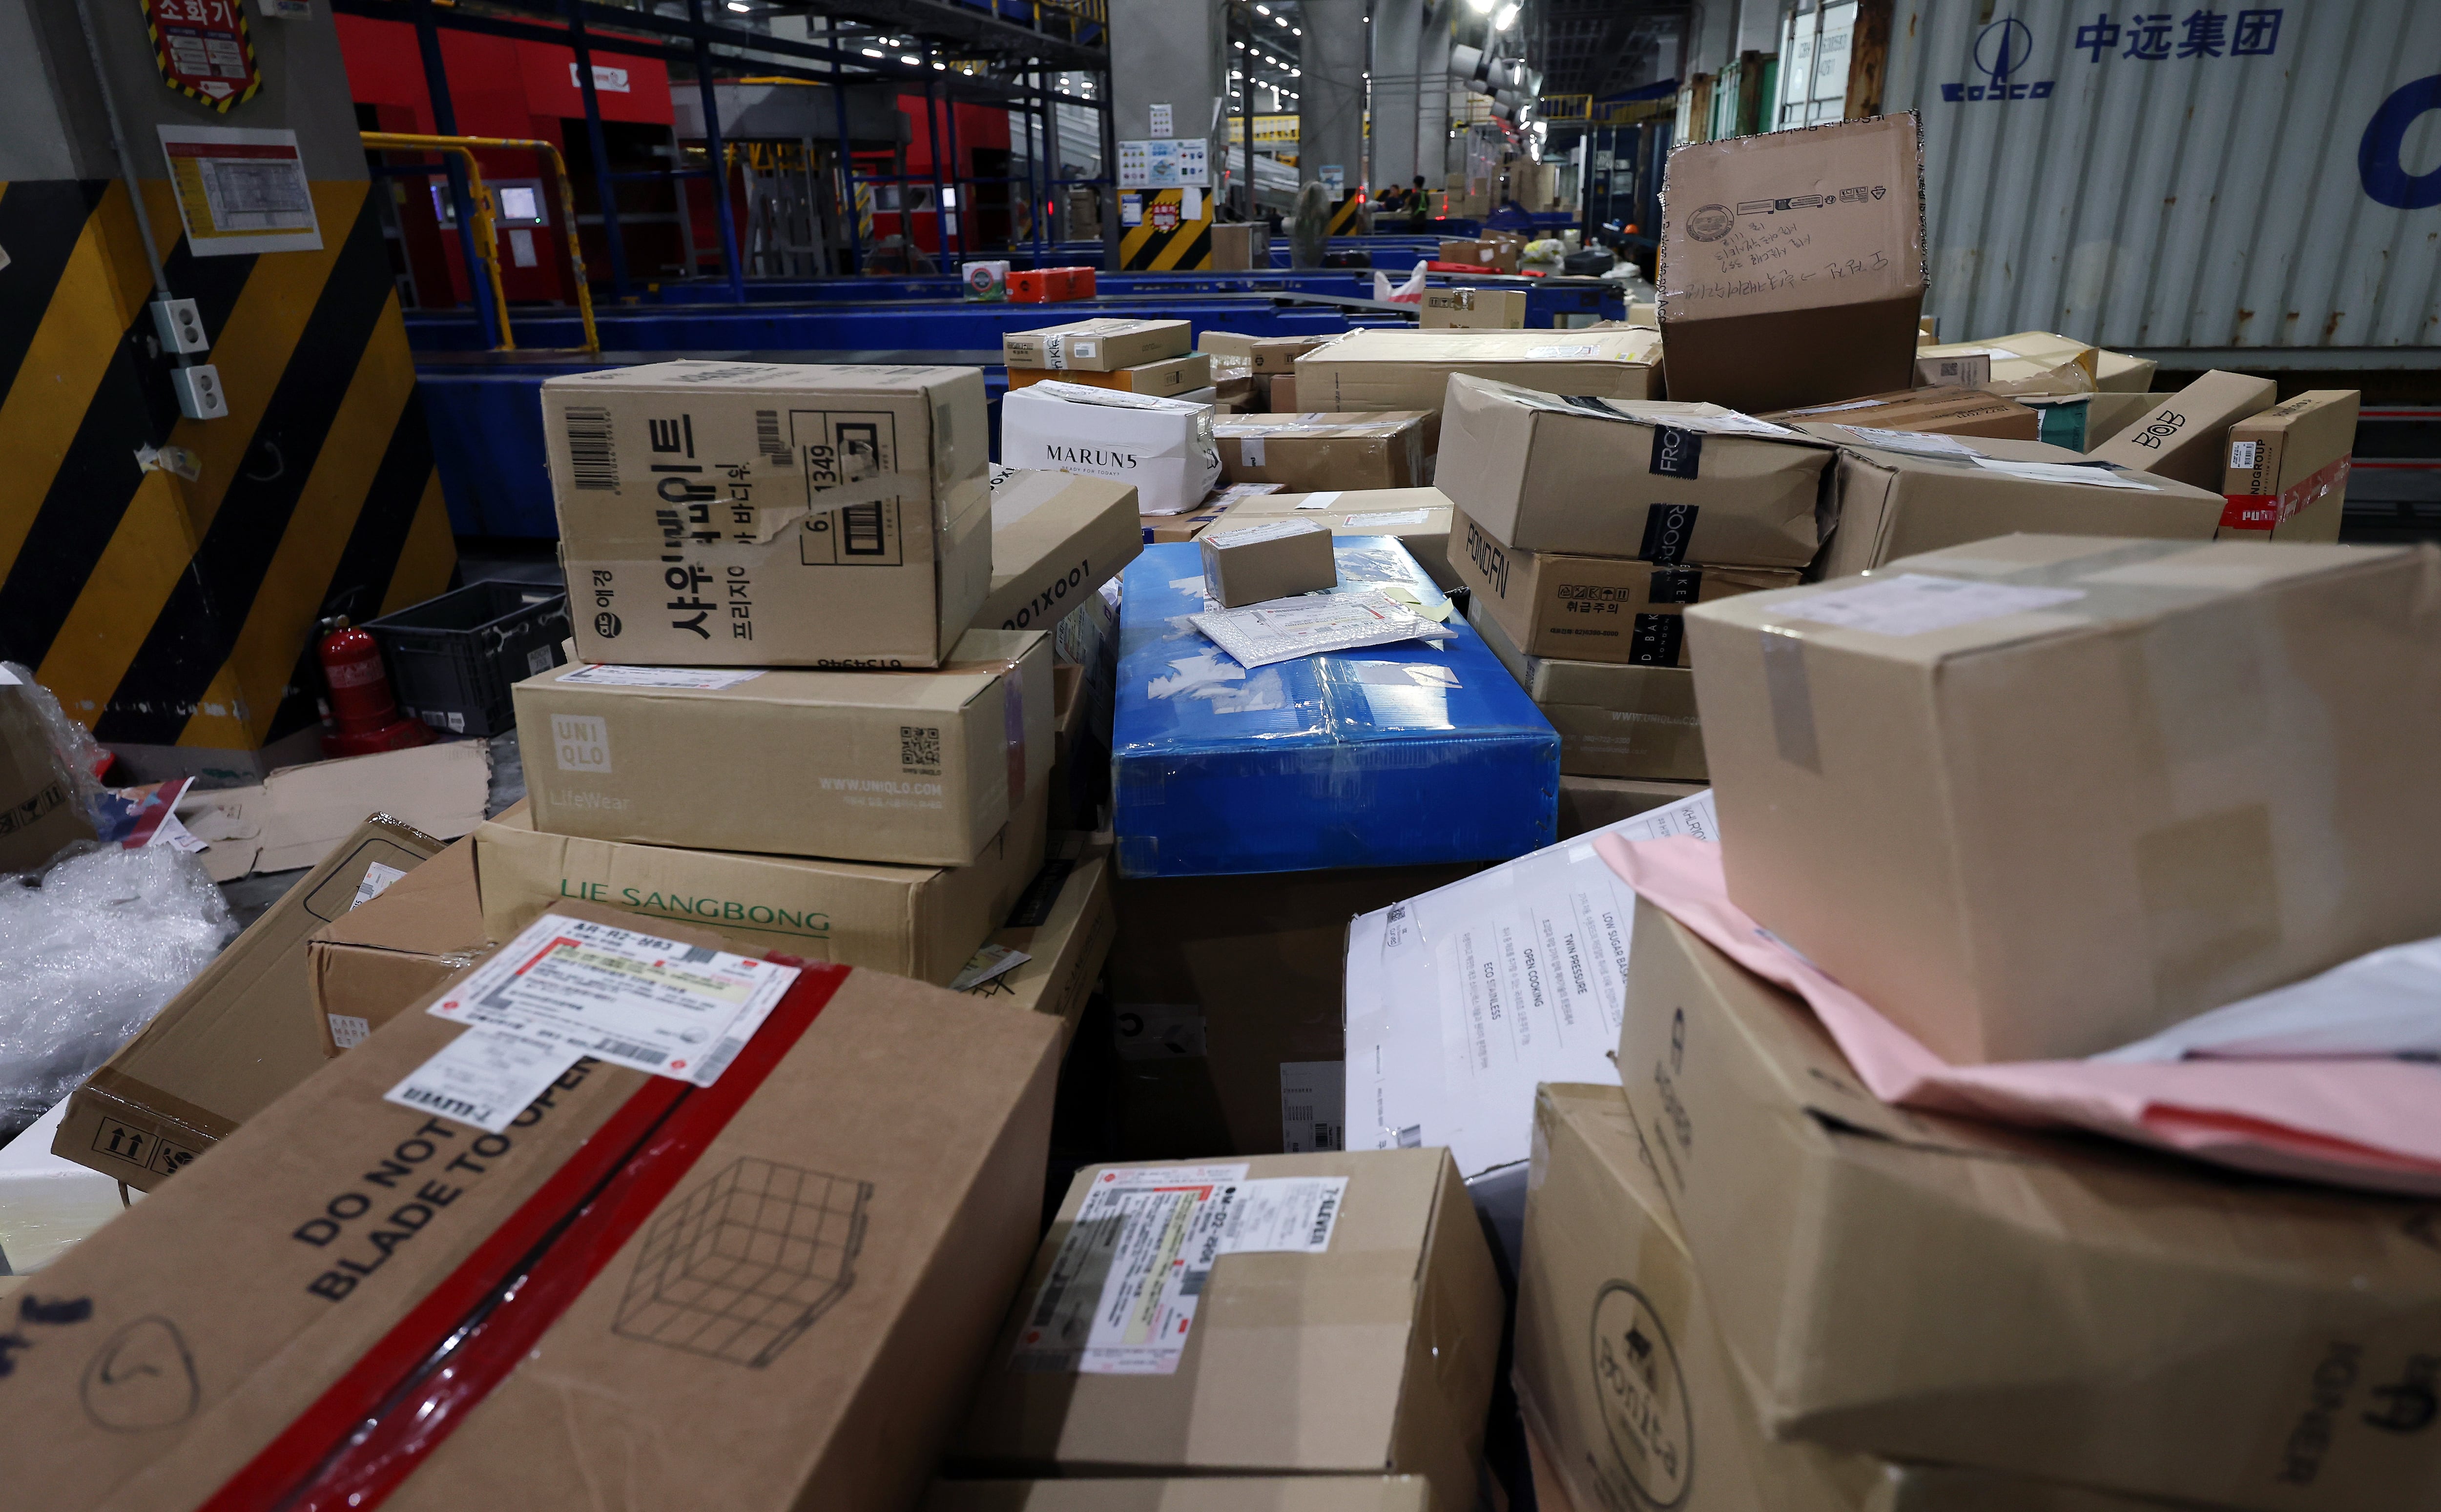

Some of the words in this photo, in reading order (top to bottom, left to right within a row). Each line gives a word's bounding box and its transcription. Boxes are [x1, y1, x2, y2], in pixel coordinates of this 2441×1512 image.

[160, 0, 234, 29] 소화기
[2075, 9, 2283, 63] 中远集团
[1941, 78, 2055, 102] COSCO
[2131, 409, 2187, 449] BOB
[1046, 445, 1138, 470] MARUN5
[593, 569, 613, 608] 애경
[1566, 601, 1619, 615] 취급주의
[557, 721, 599, 742] UNI
[562, 746, 604, 766] QLO
[818, 777, 943, 797] WWW.UNIQLO.COM
[550, 790, 631, 813] LifeWear
[560, 878, 608, 903] LIE
[621, 887, 831, 933] SANGBONG
[1602, 912, 1615, 930] LOW
[1563, 933, 1577, 954] TWIN
[1607, 930, 1624, 957] SUGAR
[1482, 961, 1495, 979] ECO
[1522, 948, 1537, 970] OPEN
[1568, 954, 1588, 995] PRESSURE
[1483, 979, 1505, 1021] STAINLESS
[1526, 970, 1546, 1008] COOKING
[292, 1182, 371, 1251] DO
[359, 1115, 459, 1189] NOT
[308, 1171, 463, 1304] BLADE
[442, 1126, 513, 1194] TO
